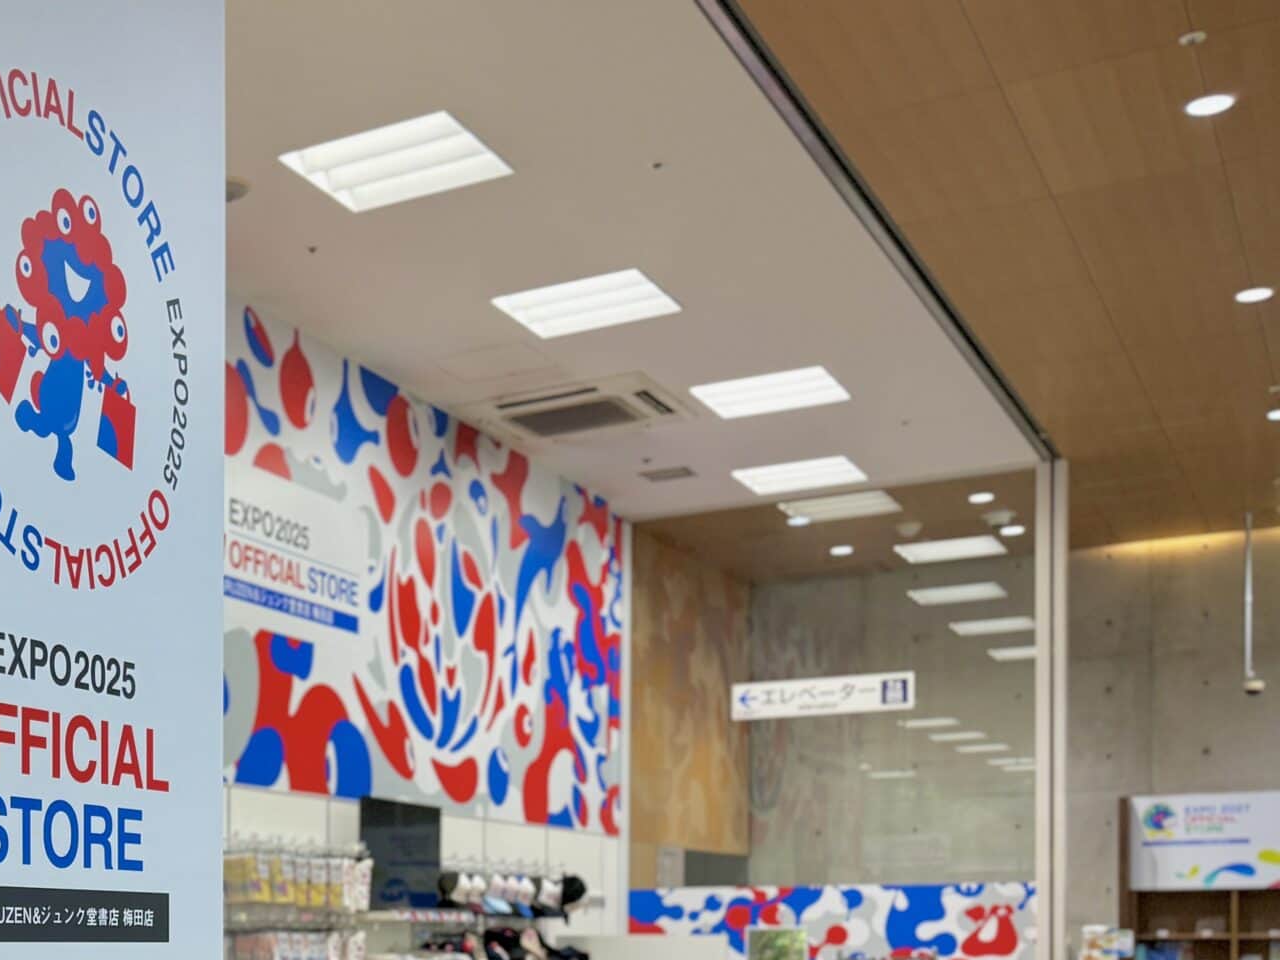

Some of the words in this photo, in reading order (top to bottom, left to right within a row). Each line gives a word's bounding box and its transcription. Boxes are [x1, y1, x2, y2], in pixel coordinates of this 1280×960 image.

[84, 109, 175, 284] STORE
[162, 297, 190, 491] EXPO2025
[43, 488, 170, 590] OFFICIAL
[228, 498, 310, 551] EXPO2025
[228, 540, 306, 590] OFFICIAL
[306, 565, 359, 608] STORE
[122, 908, 155, 928] 梅田店
